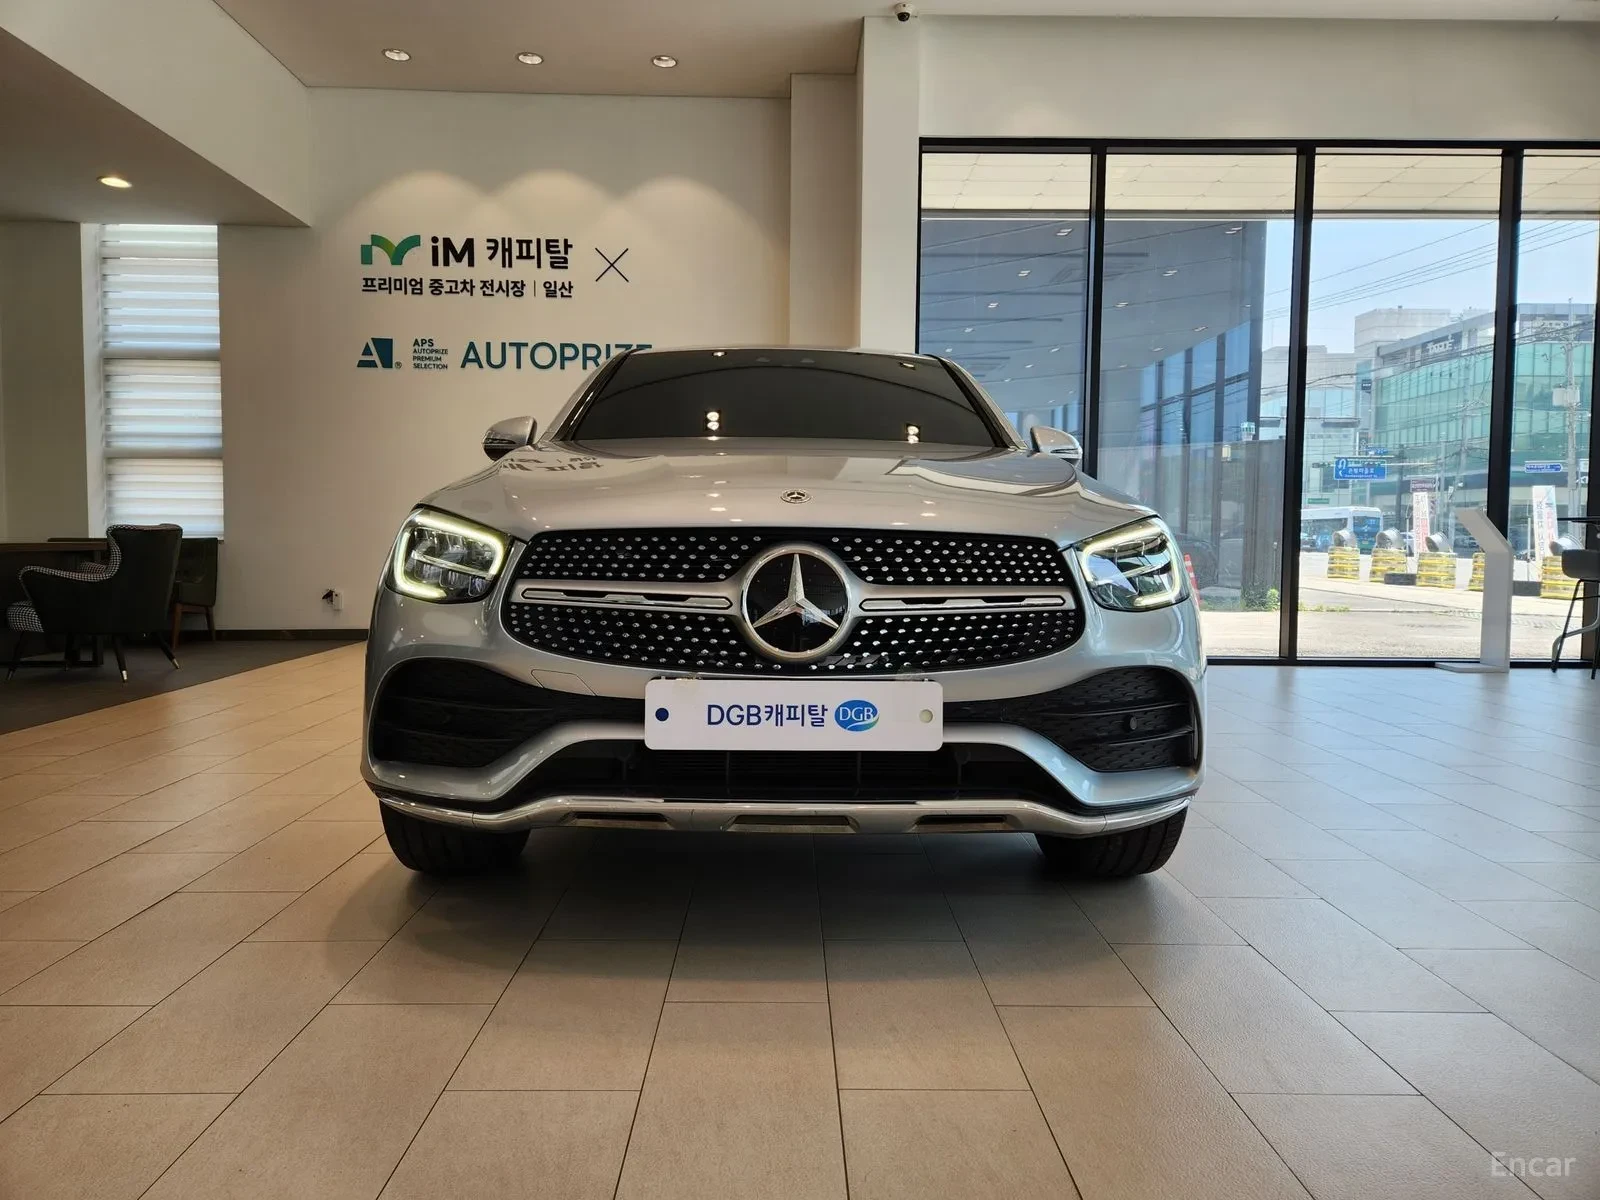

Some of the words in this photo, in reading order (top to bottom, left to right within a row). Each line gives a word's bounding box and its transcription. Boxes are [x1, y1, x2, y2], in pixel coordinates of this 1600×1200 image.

[431, 236, 475, 267] iM
[486, 237, 573, 270] 캐피탈
[361, 277, 424, 295] 프리미엄
[428, 279, 475, 296] 중고차
[479, 280, 526, 298] 전시장
[543, 281, 574, 298] 일산
[413, 338, 434, 347] APS
[460, 341, 653, 370] AUTOPRI
[707, 704, 828, 728] DGB캐피탈
[839, 706, 874, 722] DGB
